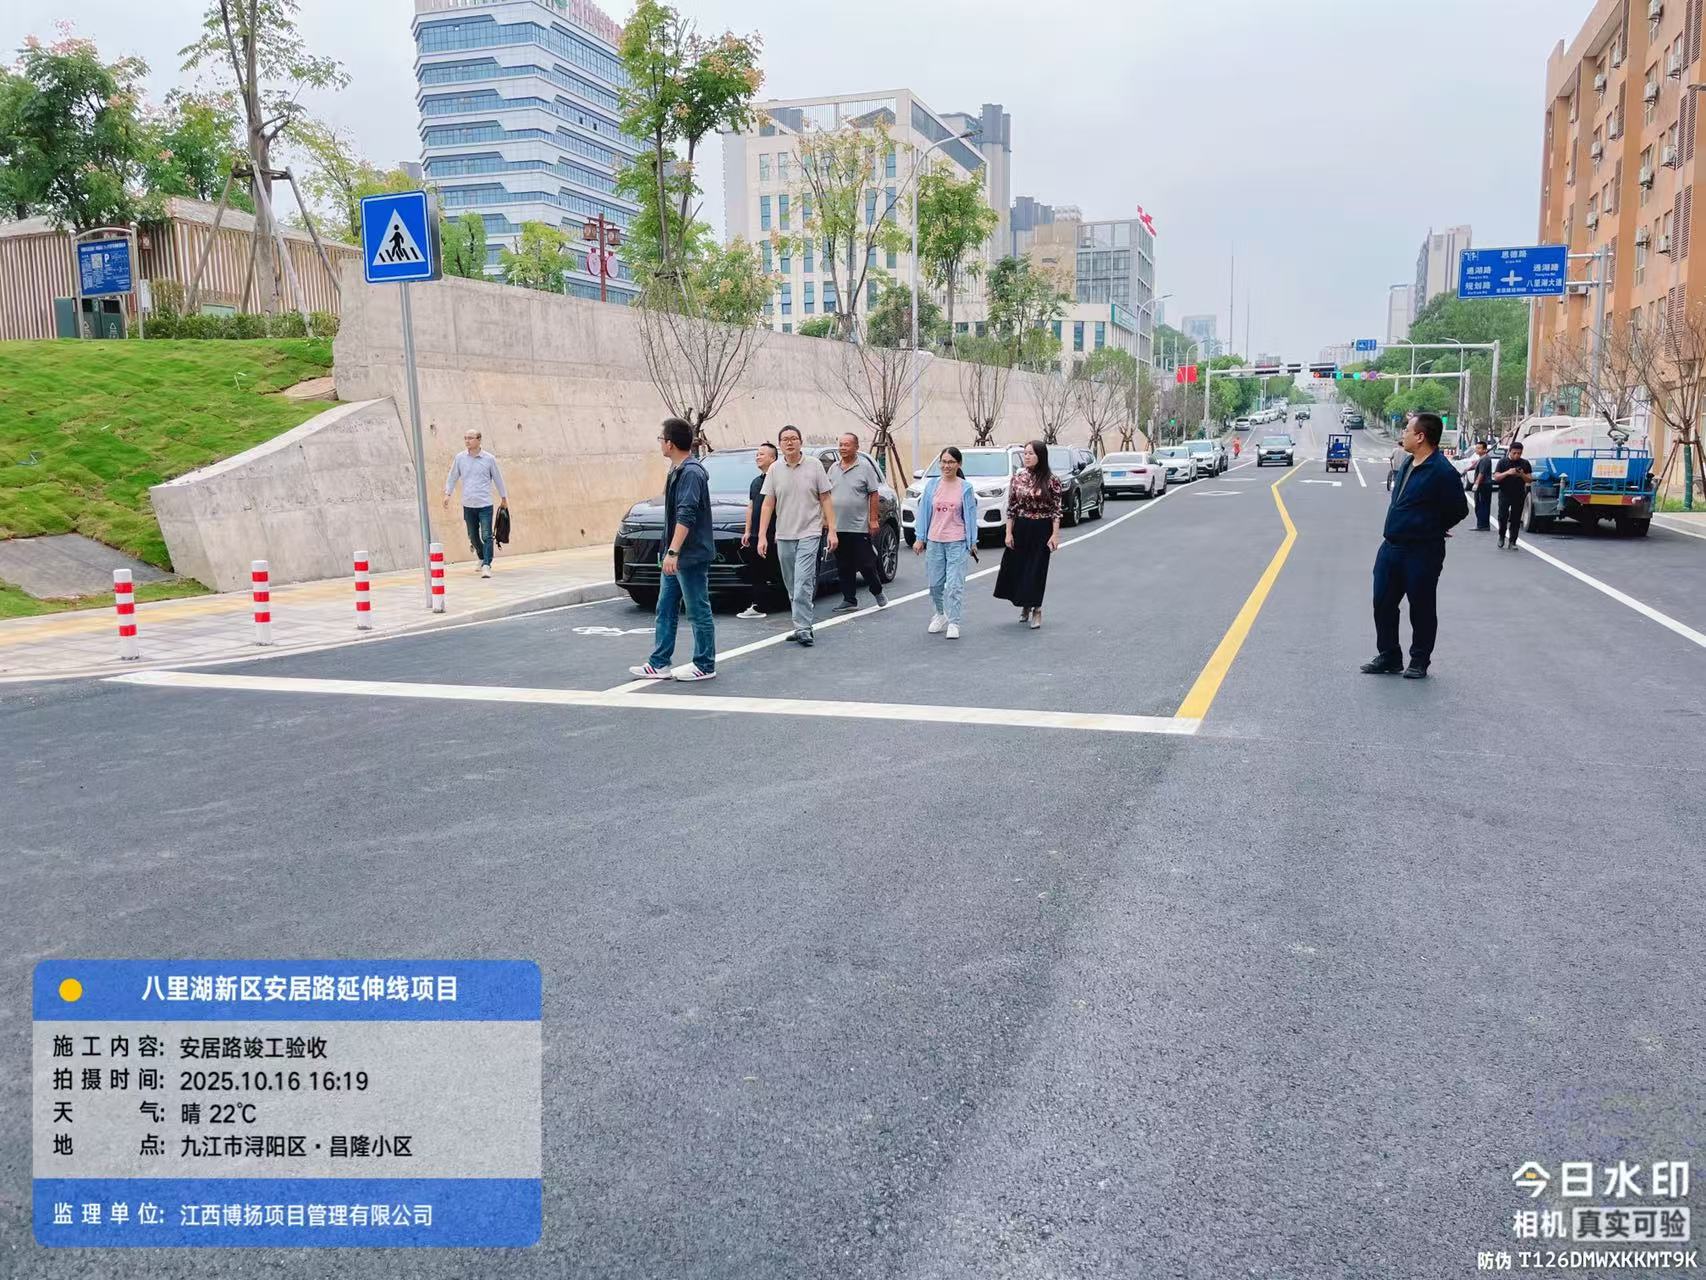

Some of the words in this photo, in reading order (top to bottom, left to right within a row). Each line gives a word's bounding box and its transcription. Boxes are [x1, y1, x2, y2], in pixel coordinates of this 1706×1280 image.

[1526, 278, 1562, 288] 八里湖大道
